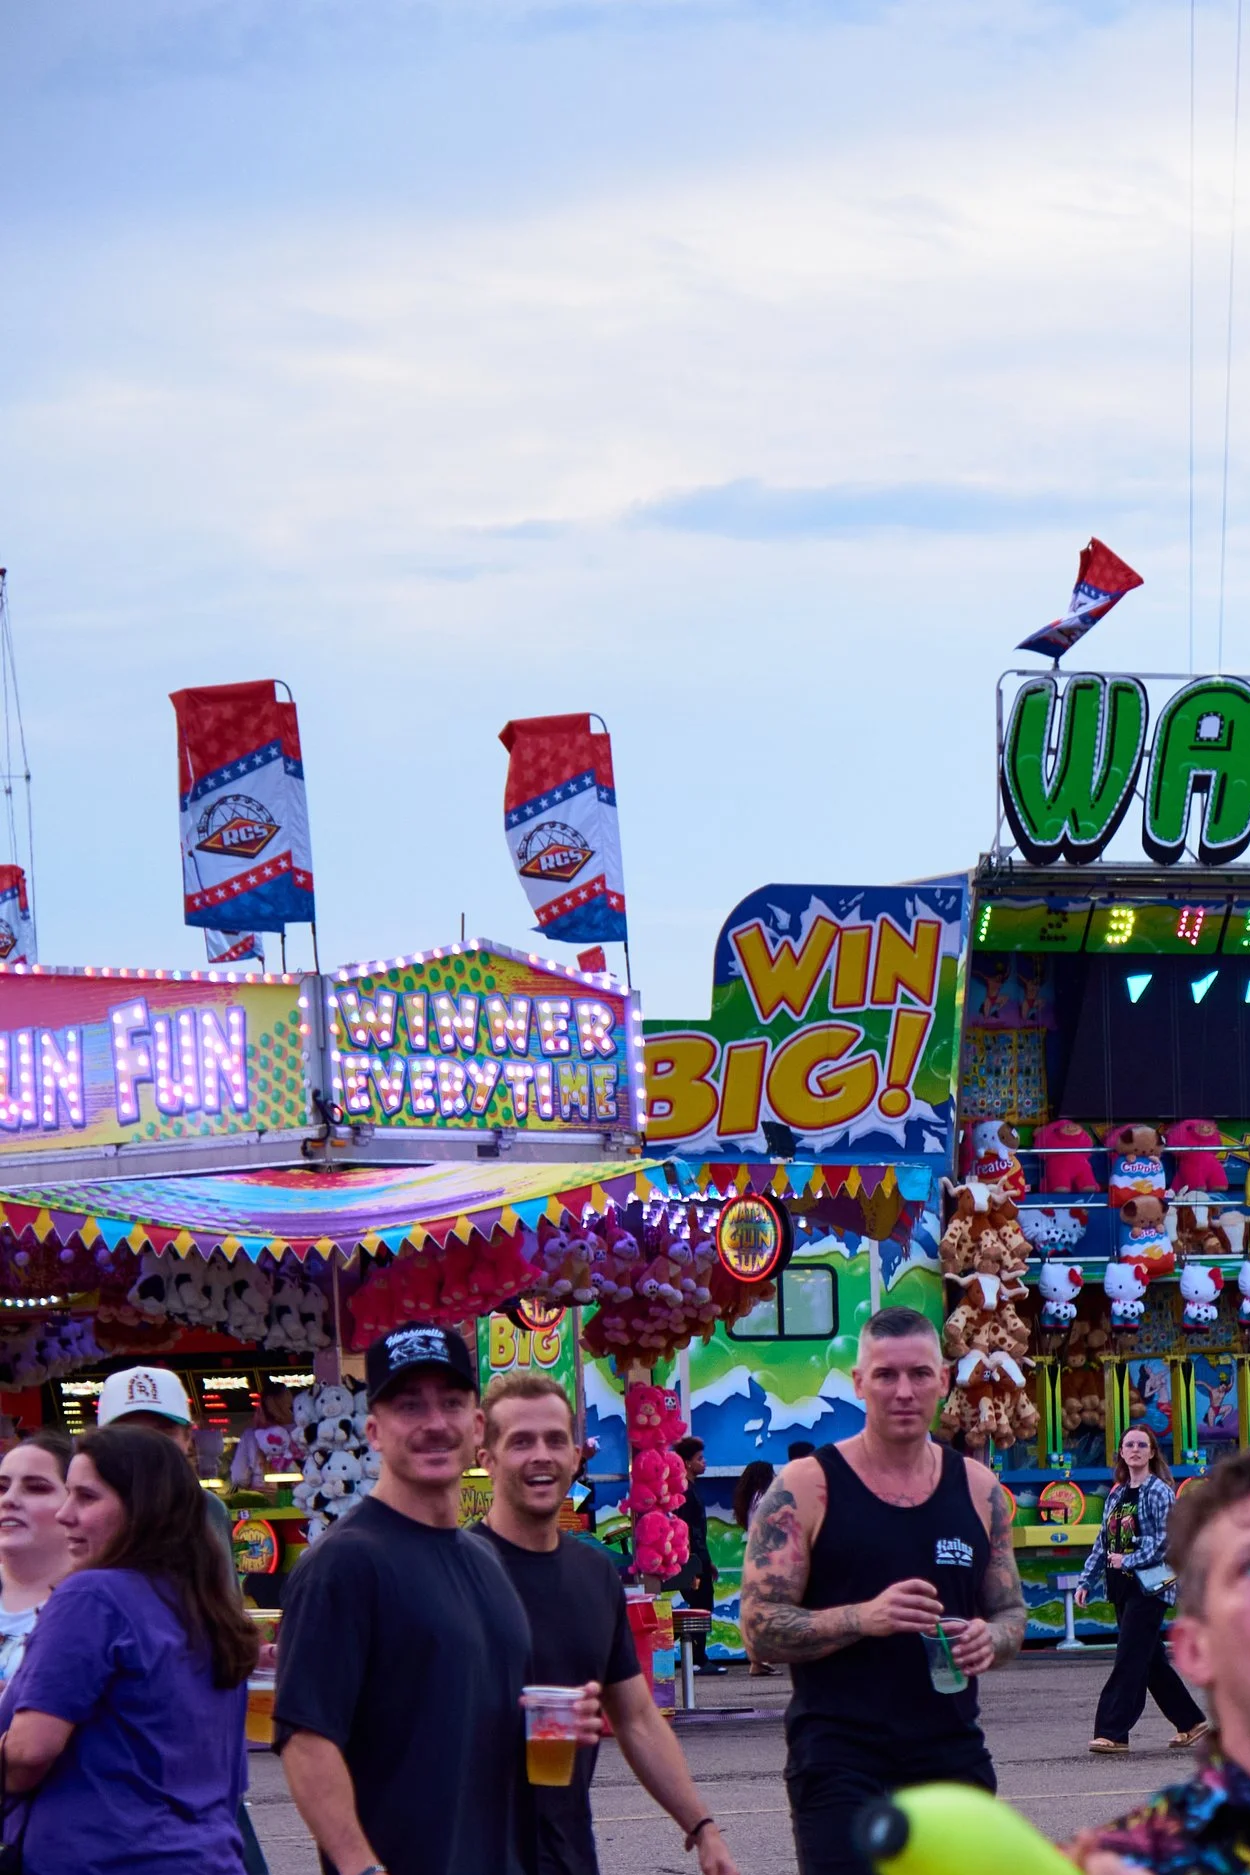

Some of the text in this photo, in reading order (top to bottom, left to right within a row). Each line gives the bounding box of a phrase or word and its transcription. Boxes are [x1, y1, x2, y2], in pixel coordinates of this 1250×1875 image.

[222, 824, 270, 847] RCS
[538, 849, 584, 872] RCS
[979, 905, 992, 943] 1
[1040, 909, 1069, 942] 2
[1106, 909, 1135, 944] 3
[1177, 909, 1204, 946] 4
[731, 913, 944, 1023] WIN
[336, 987, 618, 1060] WINNER
[107, 995, 249, 1128] FUN
[643, 1007, 935, 1143] BIG!
[340, 1053, 619, 1122] EVERY TIME
[729, 1201, 771, 1223] WATER
[726, 1226, 771, 1250] GUN
[727, 1249, 768, 1272] FUN
[490, 1312, 560, 1369] BIG
